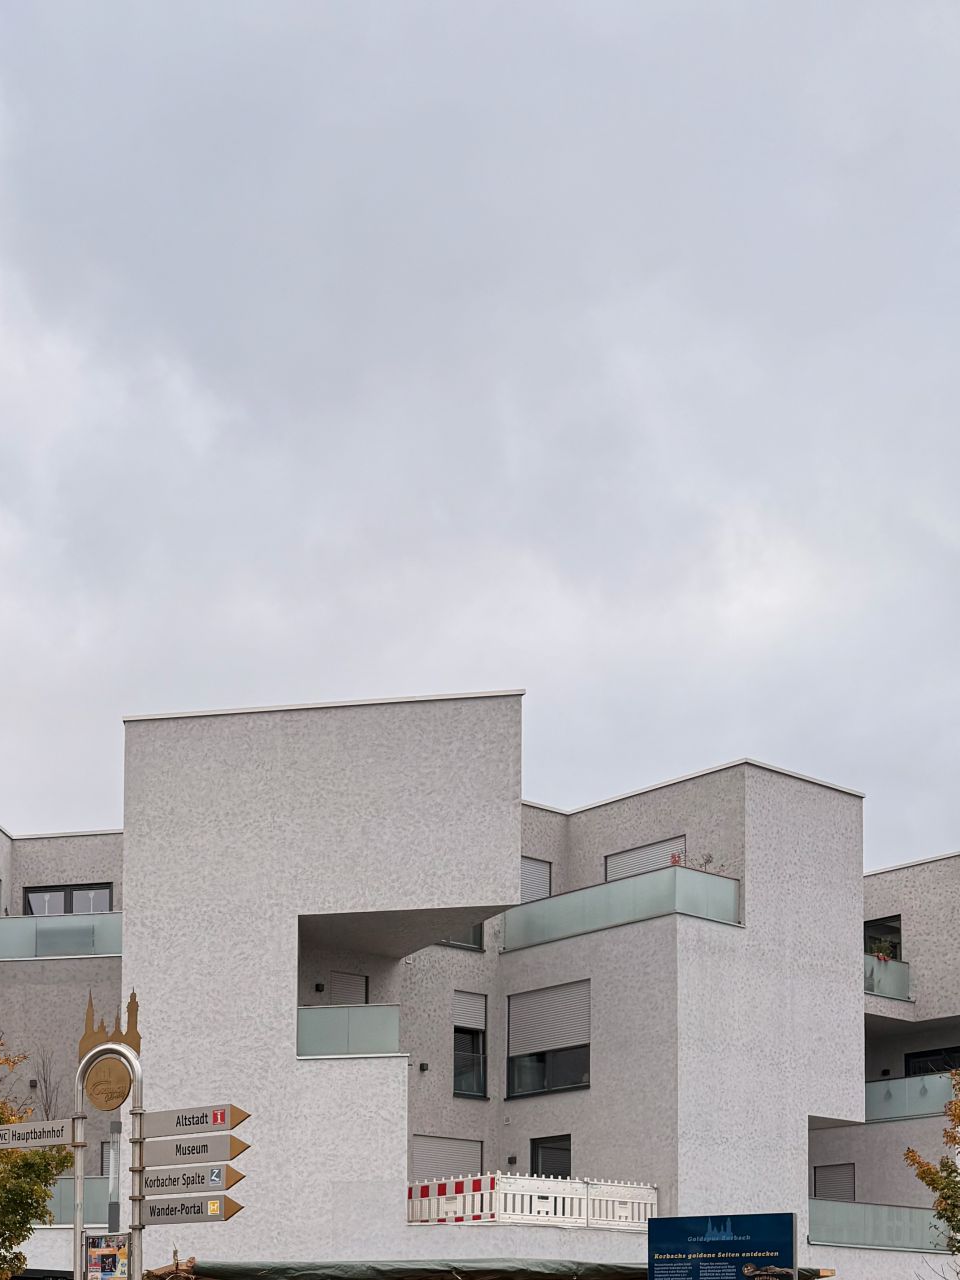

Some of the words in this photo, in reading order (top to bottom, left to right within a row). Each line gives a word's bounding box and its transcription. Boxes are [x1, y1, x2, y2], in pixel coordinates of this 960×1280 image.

[175, 1112, 209, 1128] Altstadt
[11, 1125, 65, 1143] Hauptbahnhof
[175, 1143, 209, 1156] Museum
[144, 1174, 180, 1189] Korbacher
[181, 1173, 205, 1188] Spalte
[149, 1202, 204, 1218] Wander-Portal
[721, 1234, 751, 1242] Korbach
[687, 1253, 717, 1261] goldene
